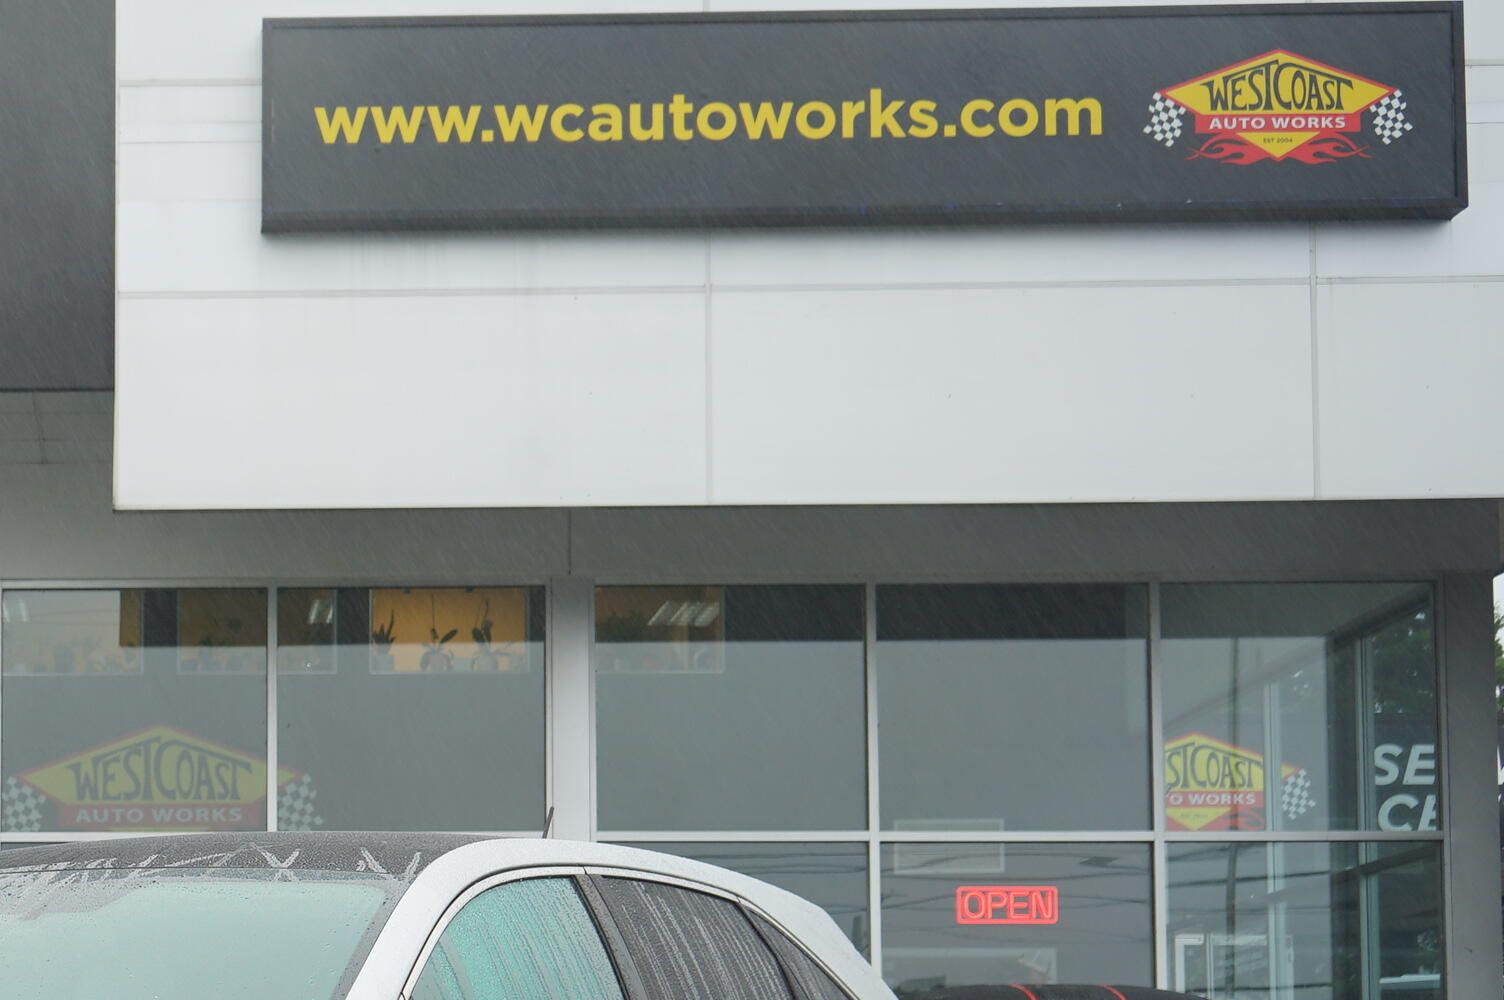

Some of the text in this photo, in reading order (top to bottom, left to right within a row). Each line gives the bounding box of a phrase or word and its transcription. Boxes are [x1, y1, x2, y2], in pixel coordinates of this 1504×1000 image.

[314, 88, 1103, 145] www.wcautoworks.com
[1209, 116, 1346, 130] AUTO WORKS
[1188, 793, 1256, 805] WORKS
[76, 807, 243, 823] AUTO WORKS
[963, 891, 1053, 919] OPEN
